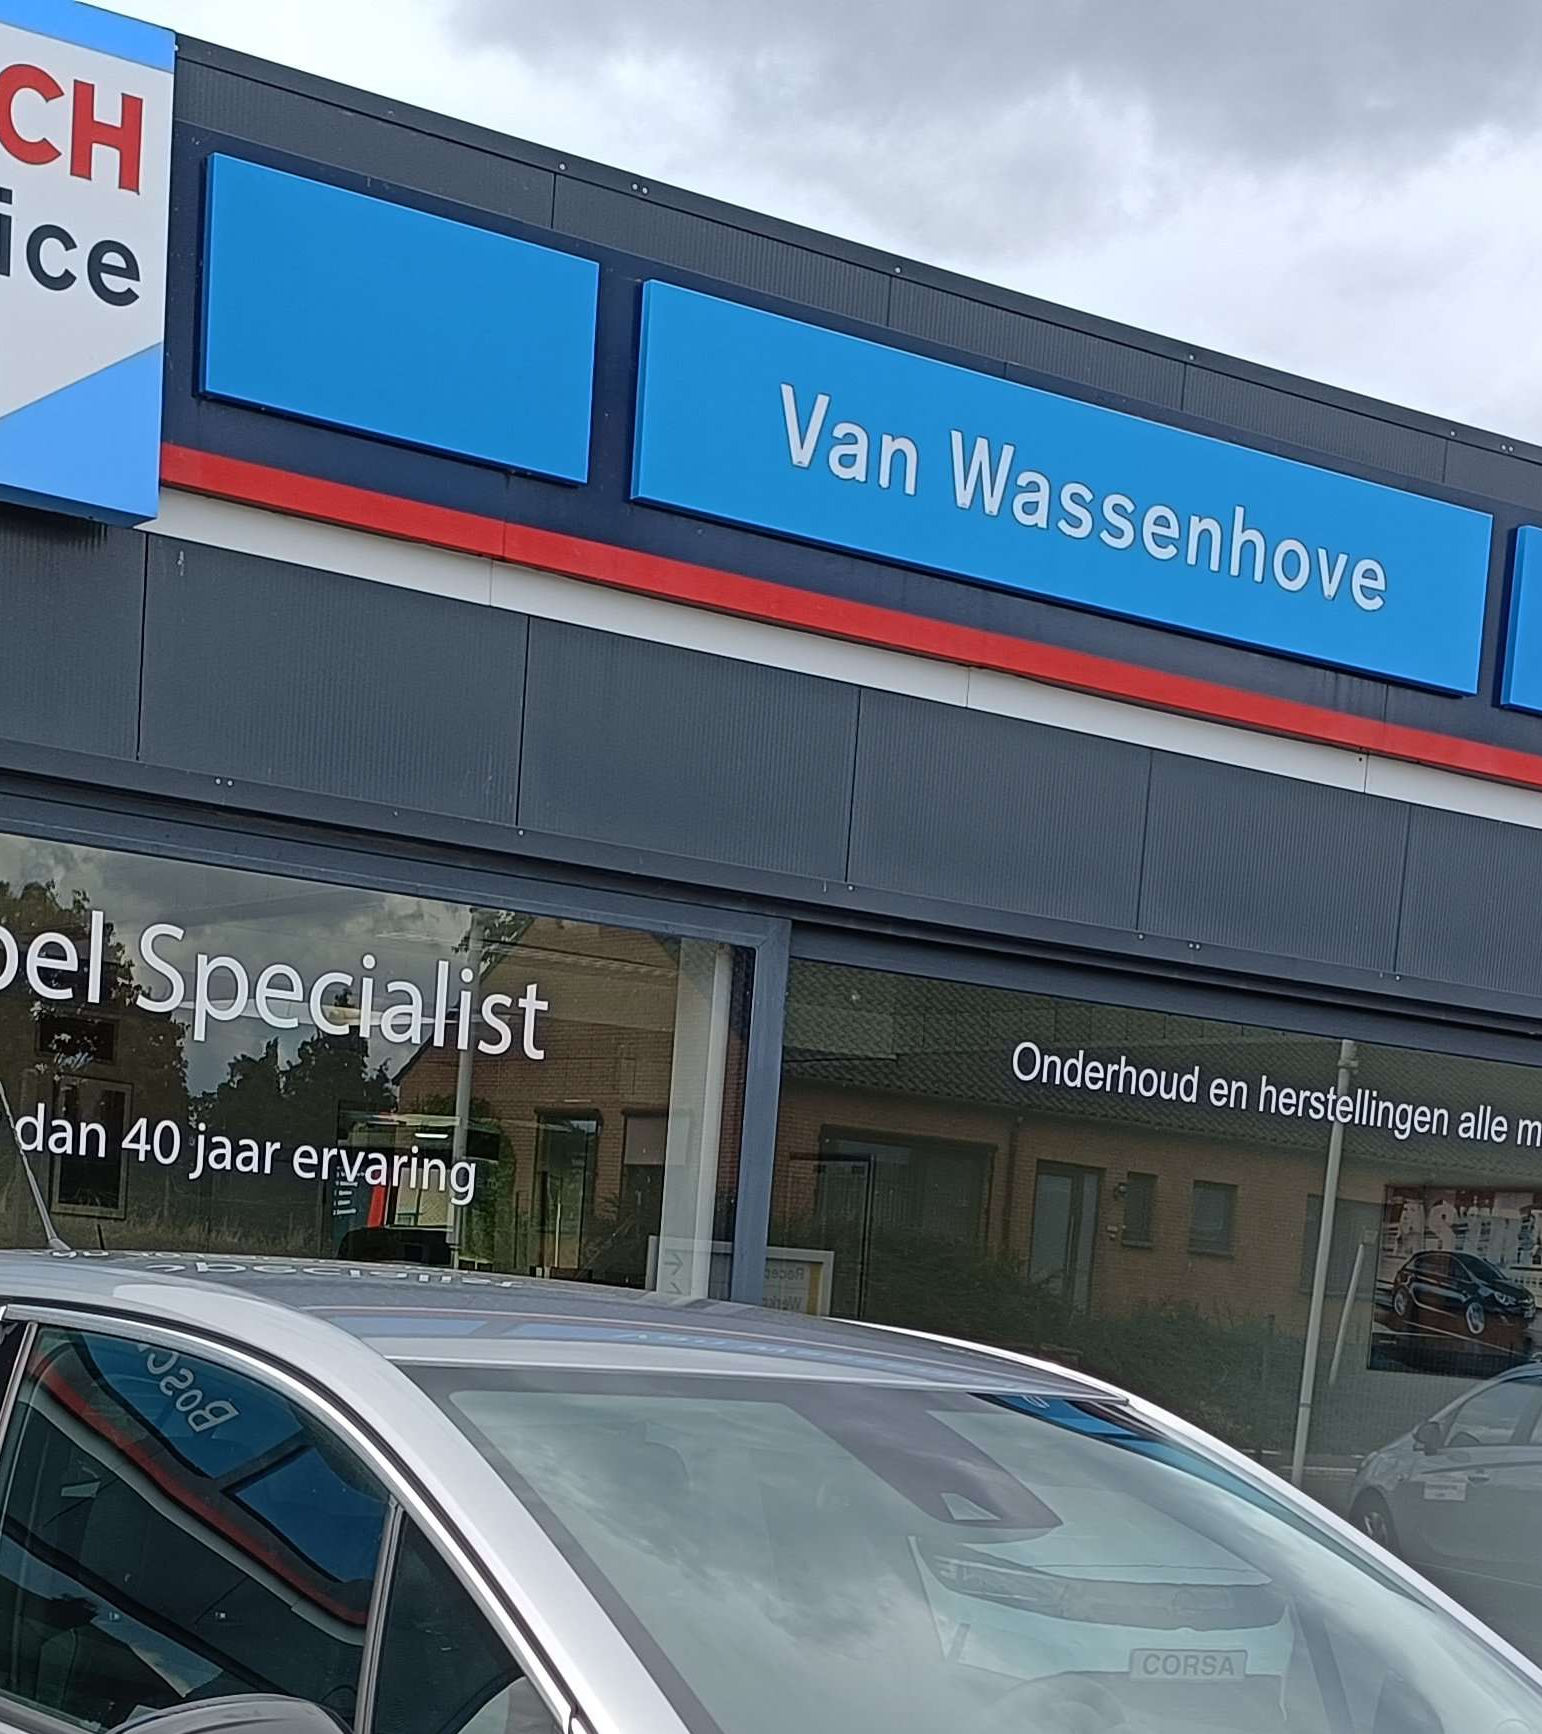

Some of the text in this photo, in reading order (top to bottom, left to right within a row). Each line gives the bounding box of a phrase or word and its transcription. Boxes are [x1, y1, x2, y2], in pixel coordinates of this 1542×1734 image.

[780, 383, 1387, 612] Van Wassenhove
[137, 923, 549, 1061] Specialist
[1012, 1041, 1200, 1104] Onderhoud
[1209, 1073, 1248, 1111] en
[1260, 1076, 1449, 1140] herstellingen
[1458, 1105, 1508, 1143] alle
[16, 1103, 107, 1160] dan
[121, 1117, 181, 1165] 40
[189, 1123, 282, 1181] jaar
[292, 1143, 477, 1205] ervaring
[1142, 1654, 1235, 1677] CORSA
